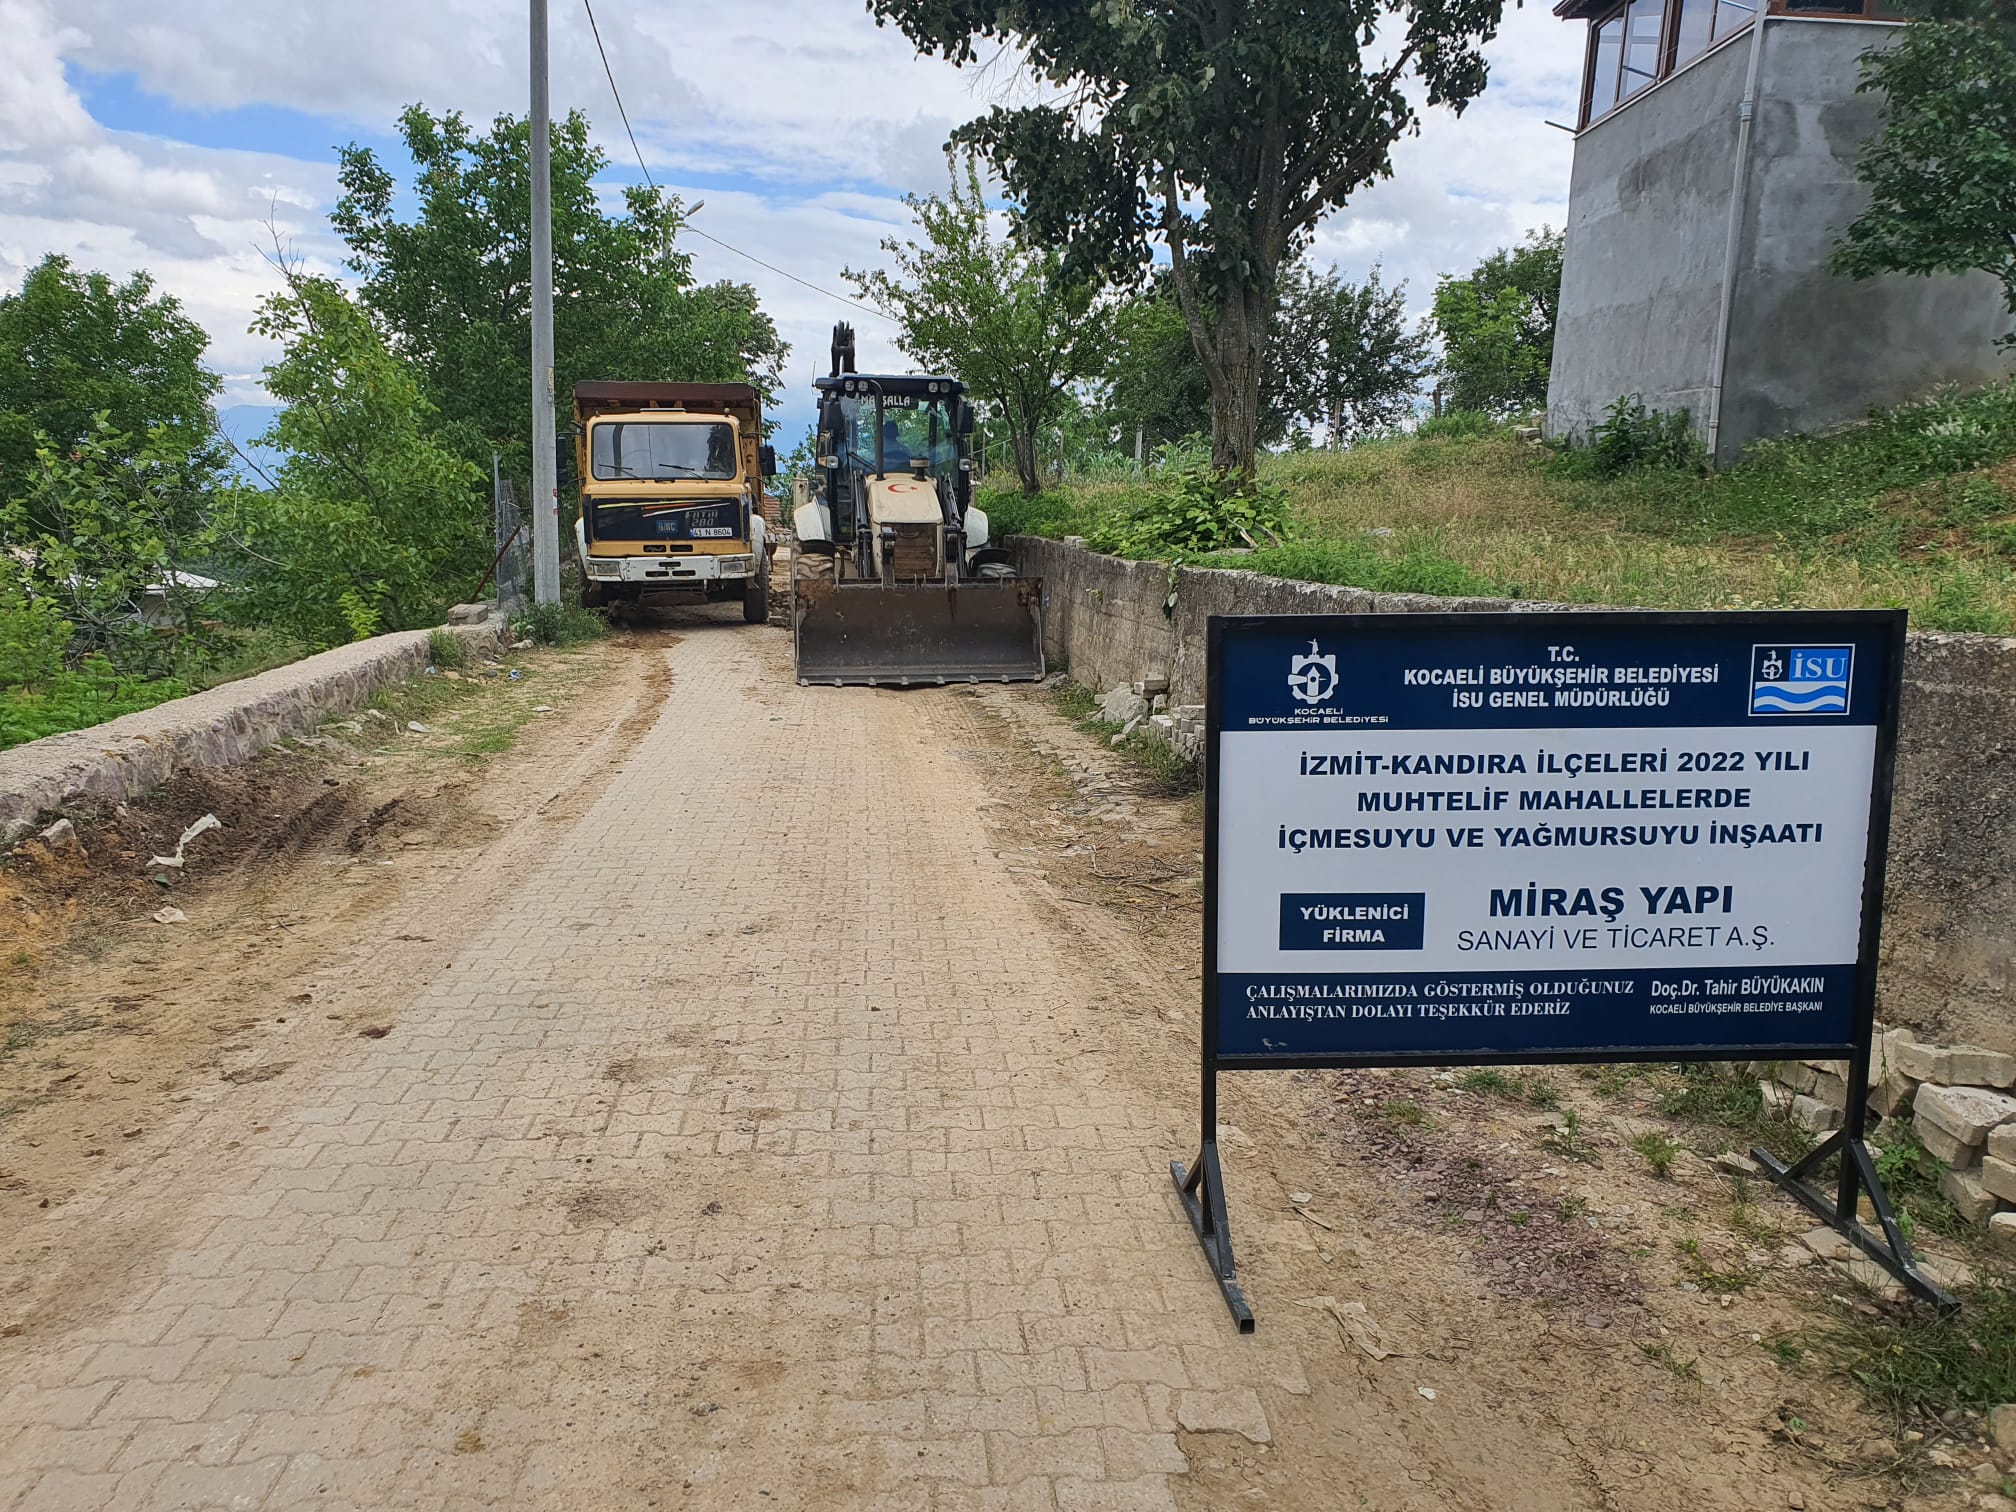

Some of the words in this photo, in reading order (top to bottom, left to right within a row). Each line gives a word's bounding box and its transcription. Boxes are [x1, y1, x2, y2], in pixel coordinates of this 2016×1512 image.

[692, 519, 713, 527] 280
[1548, 646, 1580, 662] T.C.
[1404, 666, 1484, 685] KOCAELİ
[1490, 664, 1609, 688] BÜYÜKŞEHİR
[1614, 663, 1719, 684] BELEDİYESİ
[1792, 652, 1846, 680] İSU
[1452, 689, 1483, 708] İSU
[1489, 691, 1549, 707] GENEL
[1554, 686, 1671, 707] MÜDÜRLÜĞÜ
[1300, 751, 1527, 776] İZMİT-KANDIRA
[1537, 748, 1668, 778] İLÇELERİ
[1677, 752, 1745, 772] 2022
[1755, 751, 1810, 771] YILI
[1357, 786, 1509, 811] MUHTELİF
[1519, 788, 1751, 811] MAHALLELERDE
[1278, 824, 1436, 853] İÇMESUYU
[1446, 828, 1484, 847] VE
[1494, 822, 1699, 847] YAĞMURSUYU
[1709, 820, 1823, 849] İNŞAATI
[1301, 903, 1410, 920] YÜKLENİCİ
[1489, 881, 1624, 922] MİRAŞ
[1639, 886, 1733, 914] YAPI
[1322, 927, 1385, 943] FİRMA
[1457, 926, 1555, 951] SANAYİ
[1563, 928, 1599, 950] VE
[1605, 924, 1721, 949] TİCARET
[1725, 924, 1776, 951] A.Ş.
[1246, 984, 1418, 1001] ÇALIŞMALARIMIZDA
[1424, 980, 1524, 999] GÖSTERMİŞ
[1530, 978, 1634, 995] OLDUĞUNUZ
[1651, 980, 1700, 999] Doç.Dr.
[1704, 979, 1738, 995] Tahir
[1741, 975, 1824, 995] BÜYÜKAKIN
[1246, 1004, 1346, 1021] ANLAYIŞTAN
[1351, 1003, 1412, 1018] DOLAYI
[1417, 1000, 1505, 1020] TEŞEKKÜR
[1510, 998, 1570, 1015] EDERİZ
[1650, 1001, 1687, 1014] KOCAELİ
[1688, 1000, 1741, 1015] BÜYÜKŞEHİR
[1743, 999, 1784, 1012] BELEDİYE
[1786, 1000, 1823, 1013] BAŞKANI
